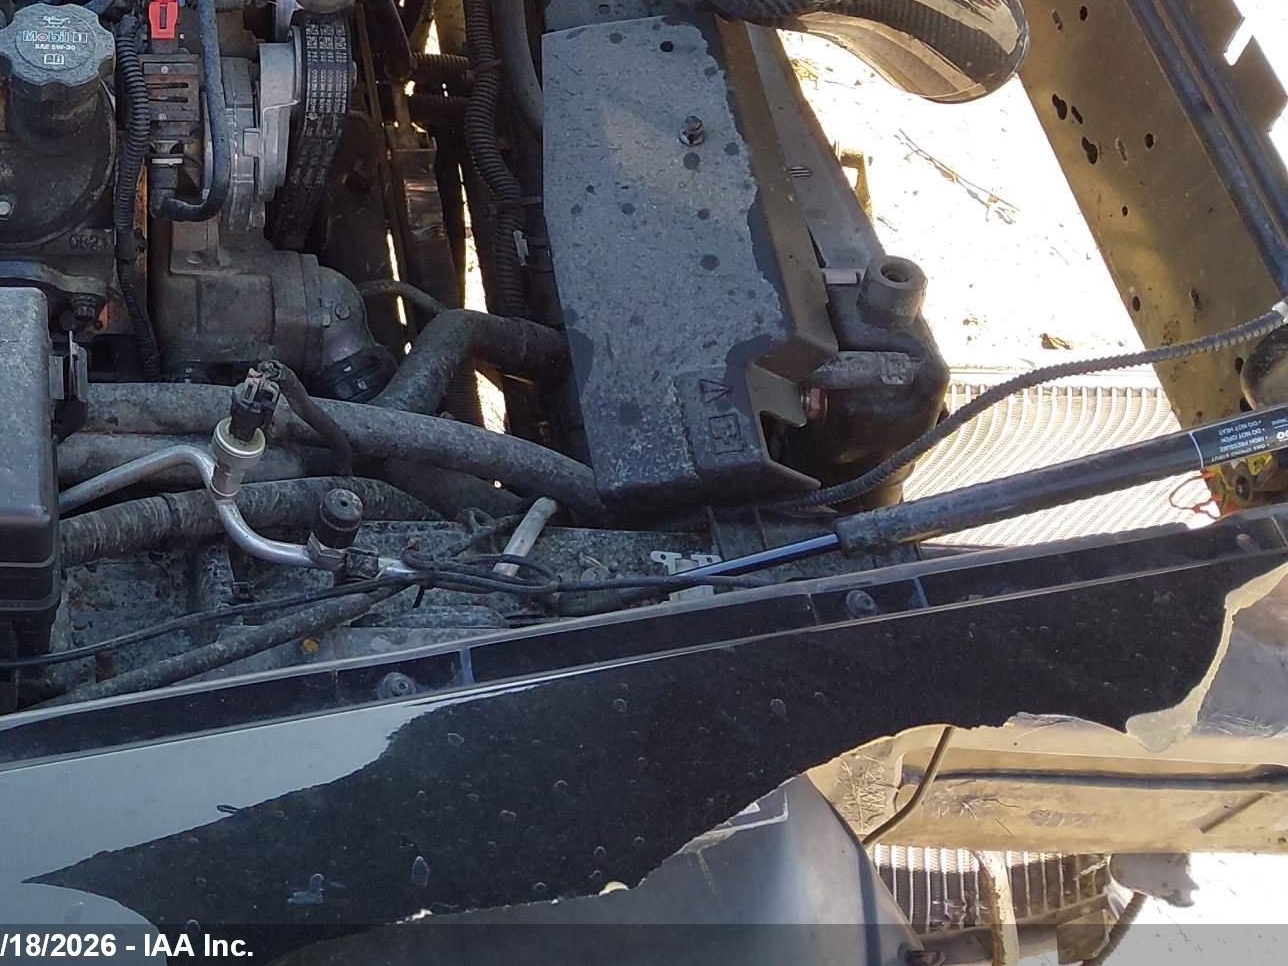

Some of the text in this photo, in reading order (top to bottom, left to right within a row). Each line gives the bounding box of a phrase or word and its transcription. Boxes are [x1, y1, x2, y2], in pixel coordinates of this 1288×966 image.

[23, 30, 69, 43] Mobil
[1219, 440, 1248, 452] PRESSURE
[1210, 453, 1229, 461] STRUT
